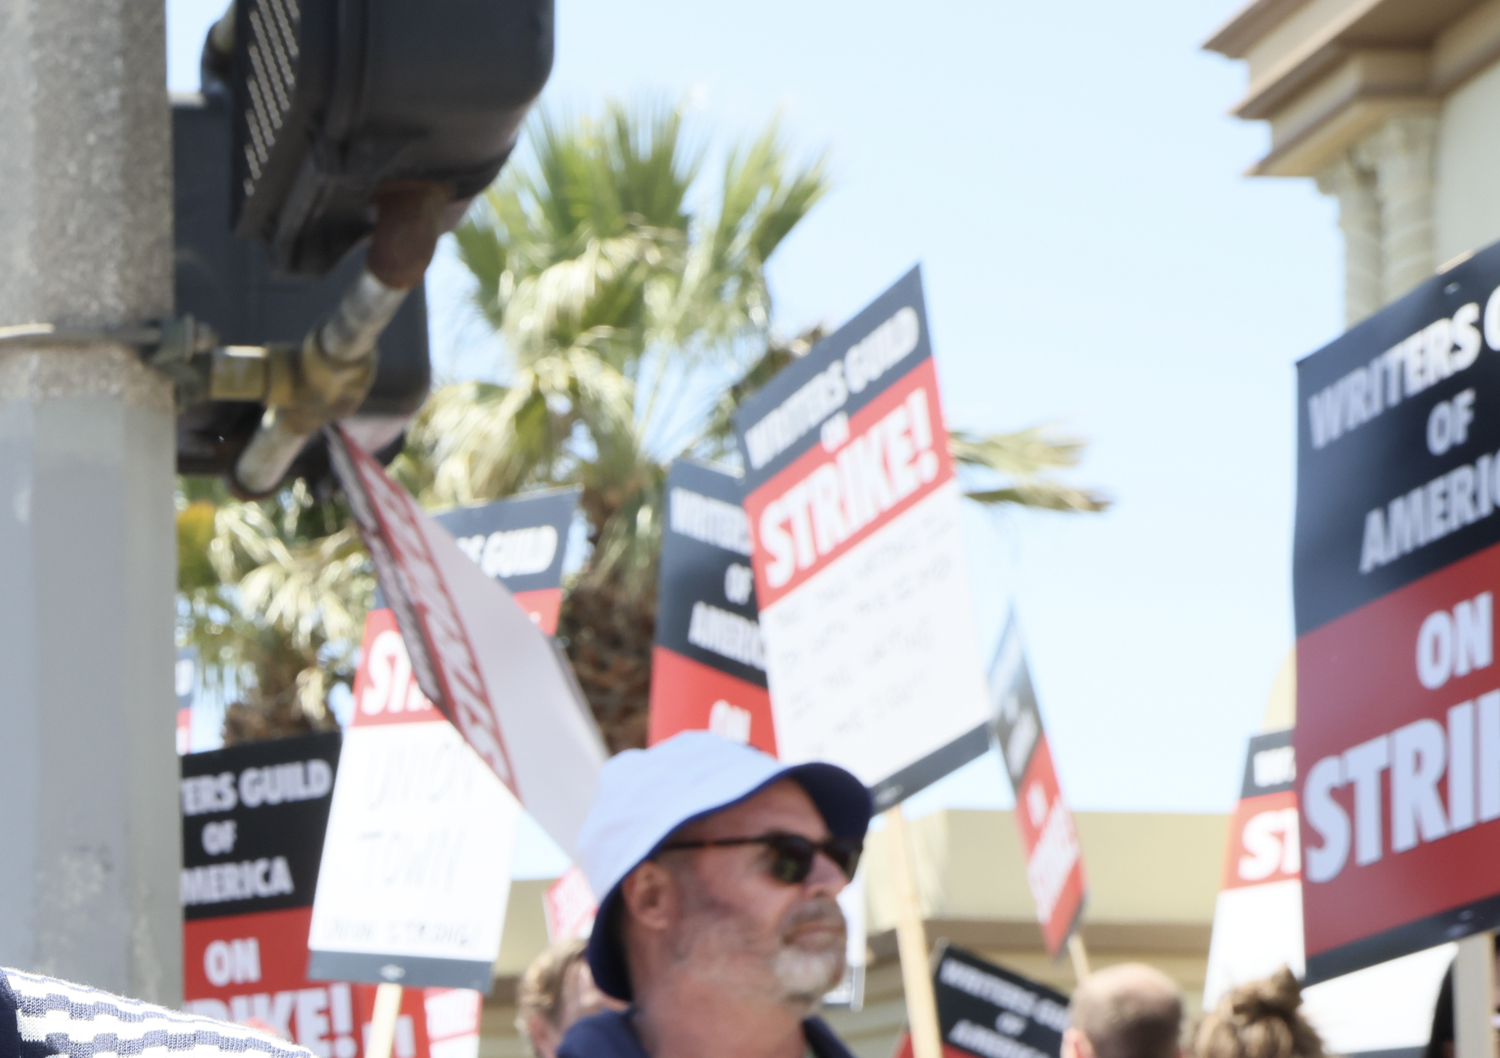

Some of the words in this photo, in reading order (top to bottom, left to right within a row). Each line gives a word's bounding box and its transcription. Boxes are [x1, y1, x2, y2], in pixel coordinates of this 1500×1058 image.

[744, 359, 849, 470] WRITERS
[844, 306, 920, 394] GUILD
[1308, 302, 1481, 449] WRITERS
[1426, 387, 1476, 457] OF
[758, 387, 939, 590] STRIKE!
[481, 525, 559, 578] GUILD
[1415, 589, 1494, 690] ON
[238, 759, 333, 808] GUILD
[201, 819, 237, 856] OF
[204, 937, 261, 987] ON
